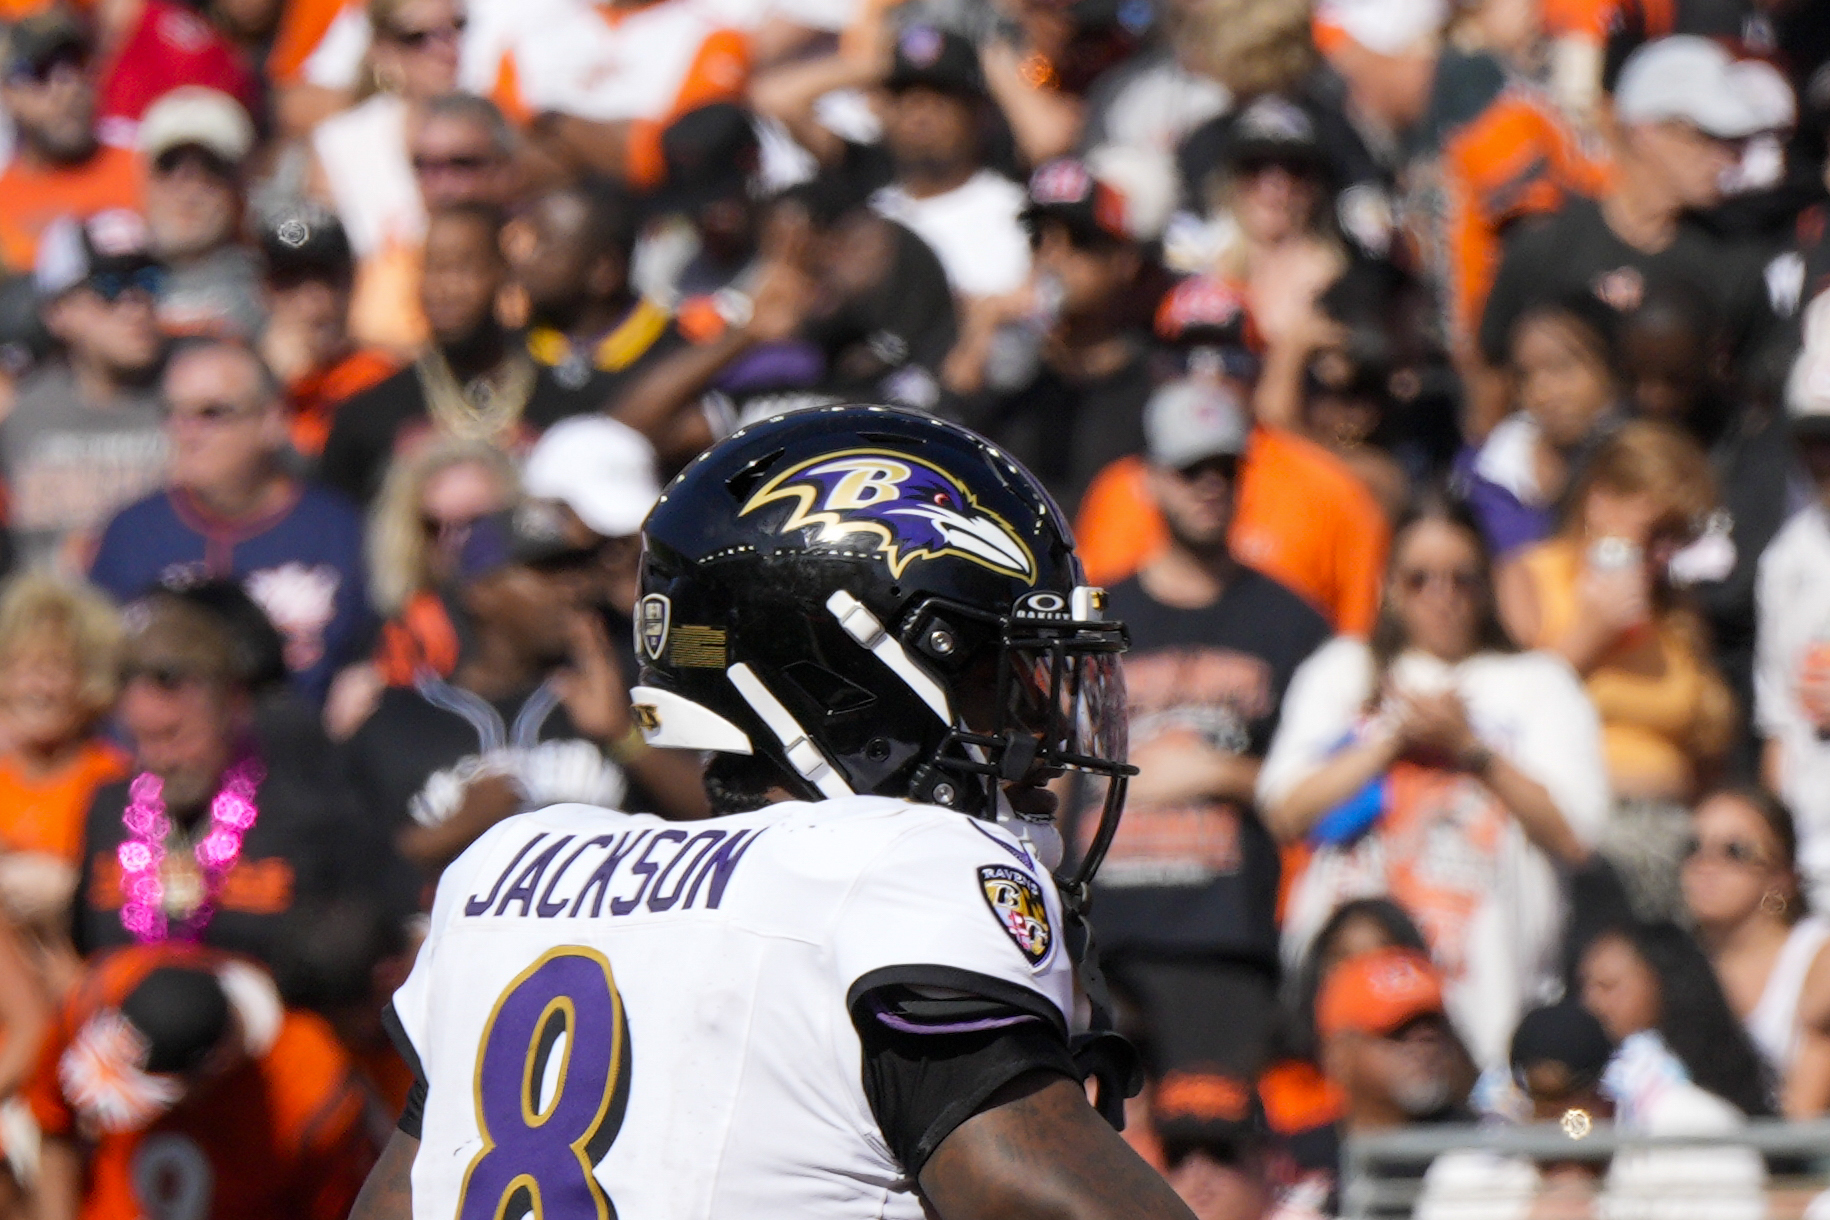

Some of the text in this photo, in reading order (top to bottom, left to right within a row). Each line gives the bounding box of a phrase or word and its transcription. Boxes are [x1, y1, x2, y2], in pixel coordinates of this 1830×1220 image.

[806, 457, 911, 511] B
[1016, 610, 1070, 620] OAKLEY
[464, 826, 769, 919] JACKSON
[981, 868, 1040, 896] RAVENS
